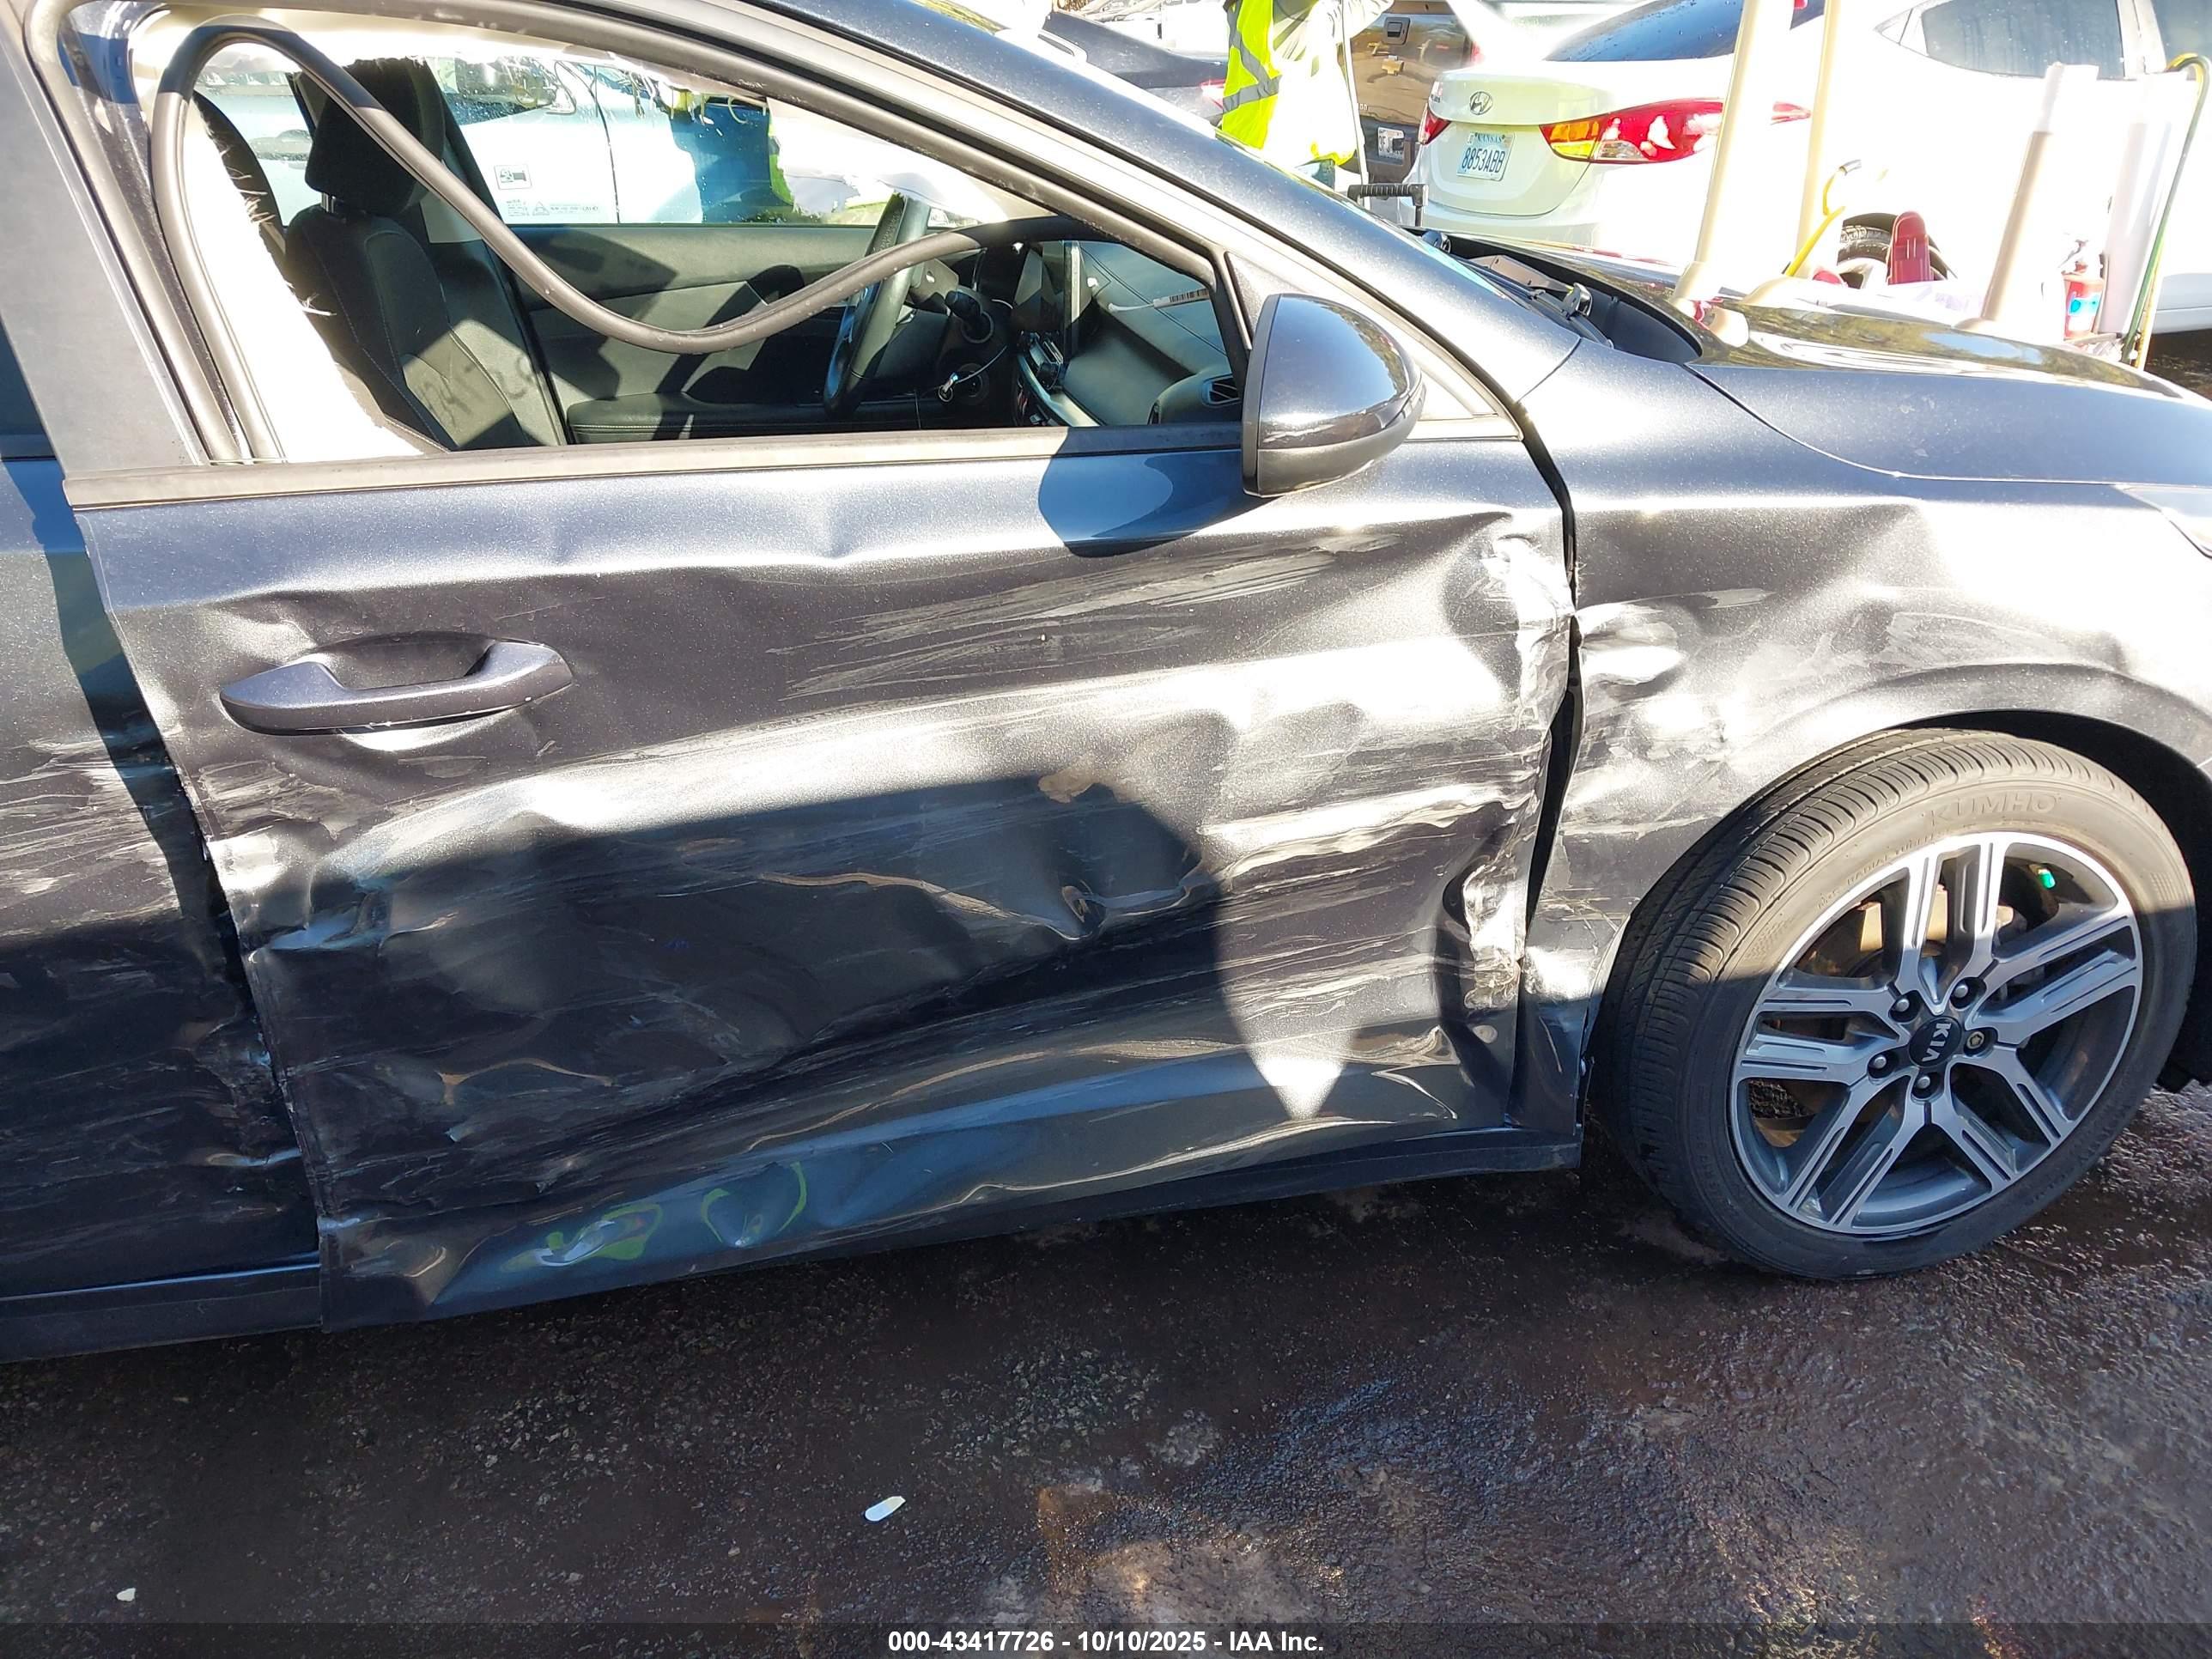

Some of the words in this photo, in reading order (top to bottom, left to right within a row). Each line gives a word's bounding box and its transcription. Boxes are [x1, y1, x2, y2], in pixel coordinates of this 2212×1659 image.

[1462, 147, 1506, 173] 8853ABB
[1930, 792, 2056, 827] KUMHO
[1921, 1023, 1952, 1062] KIA
